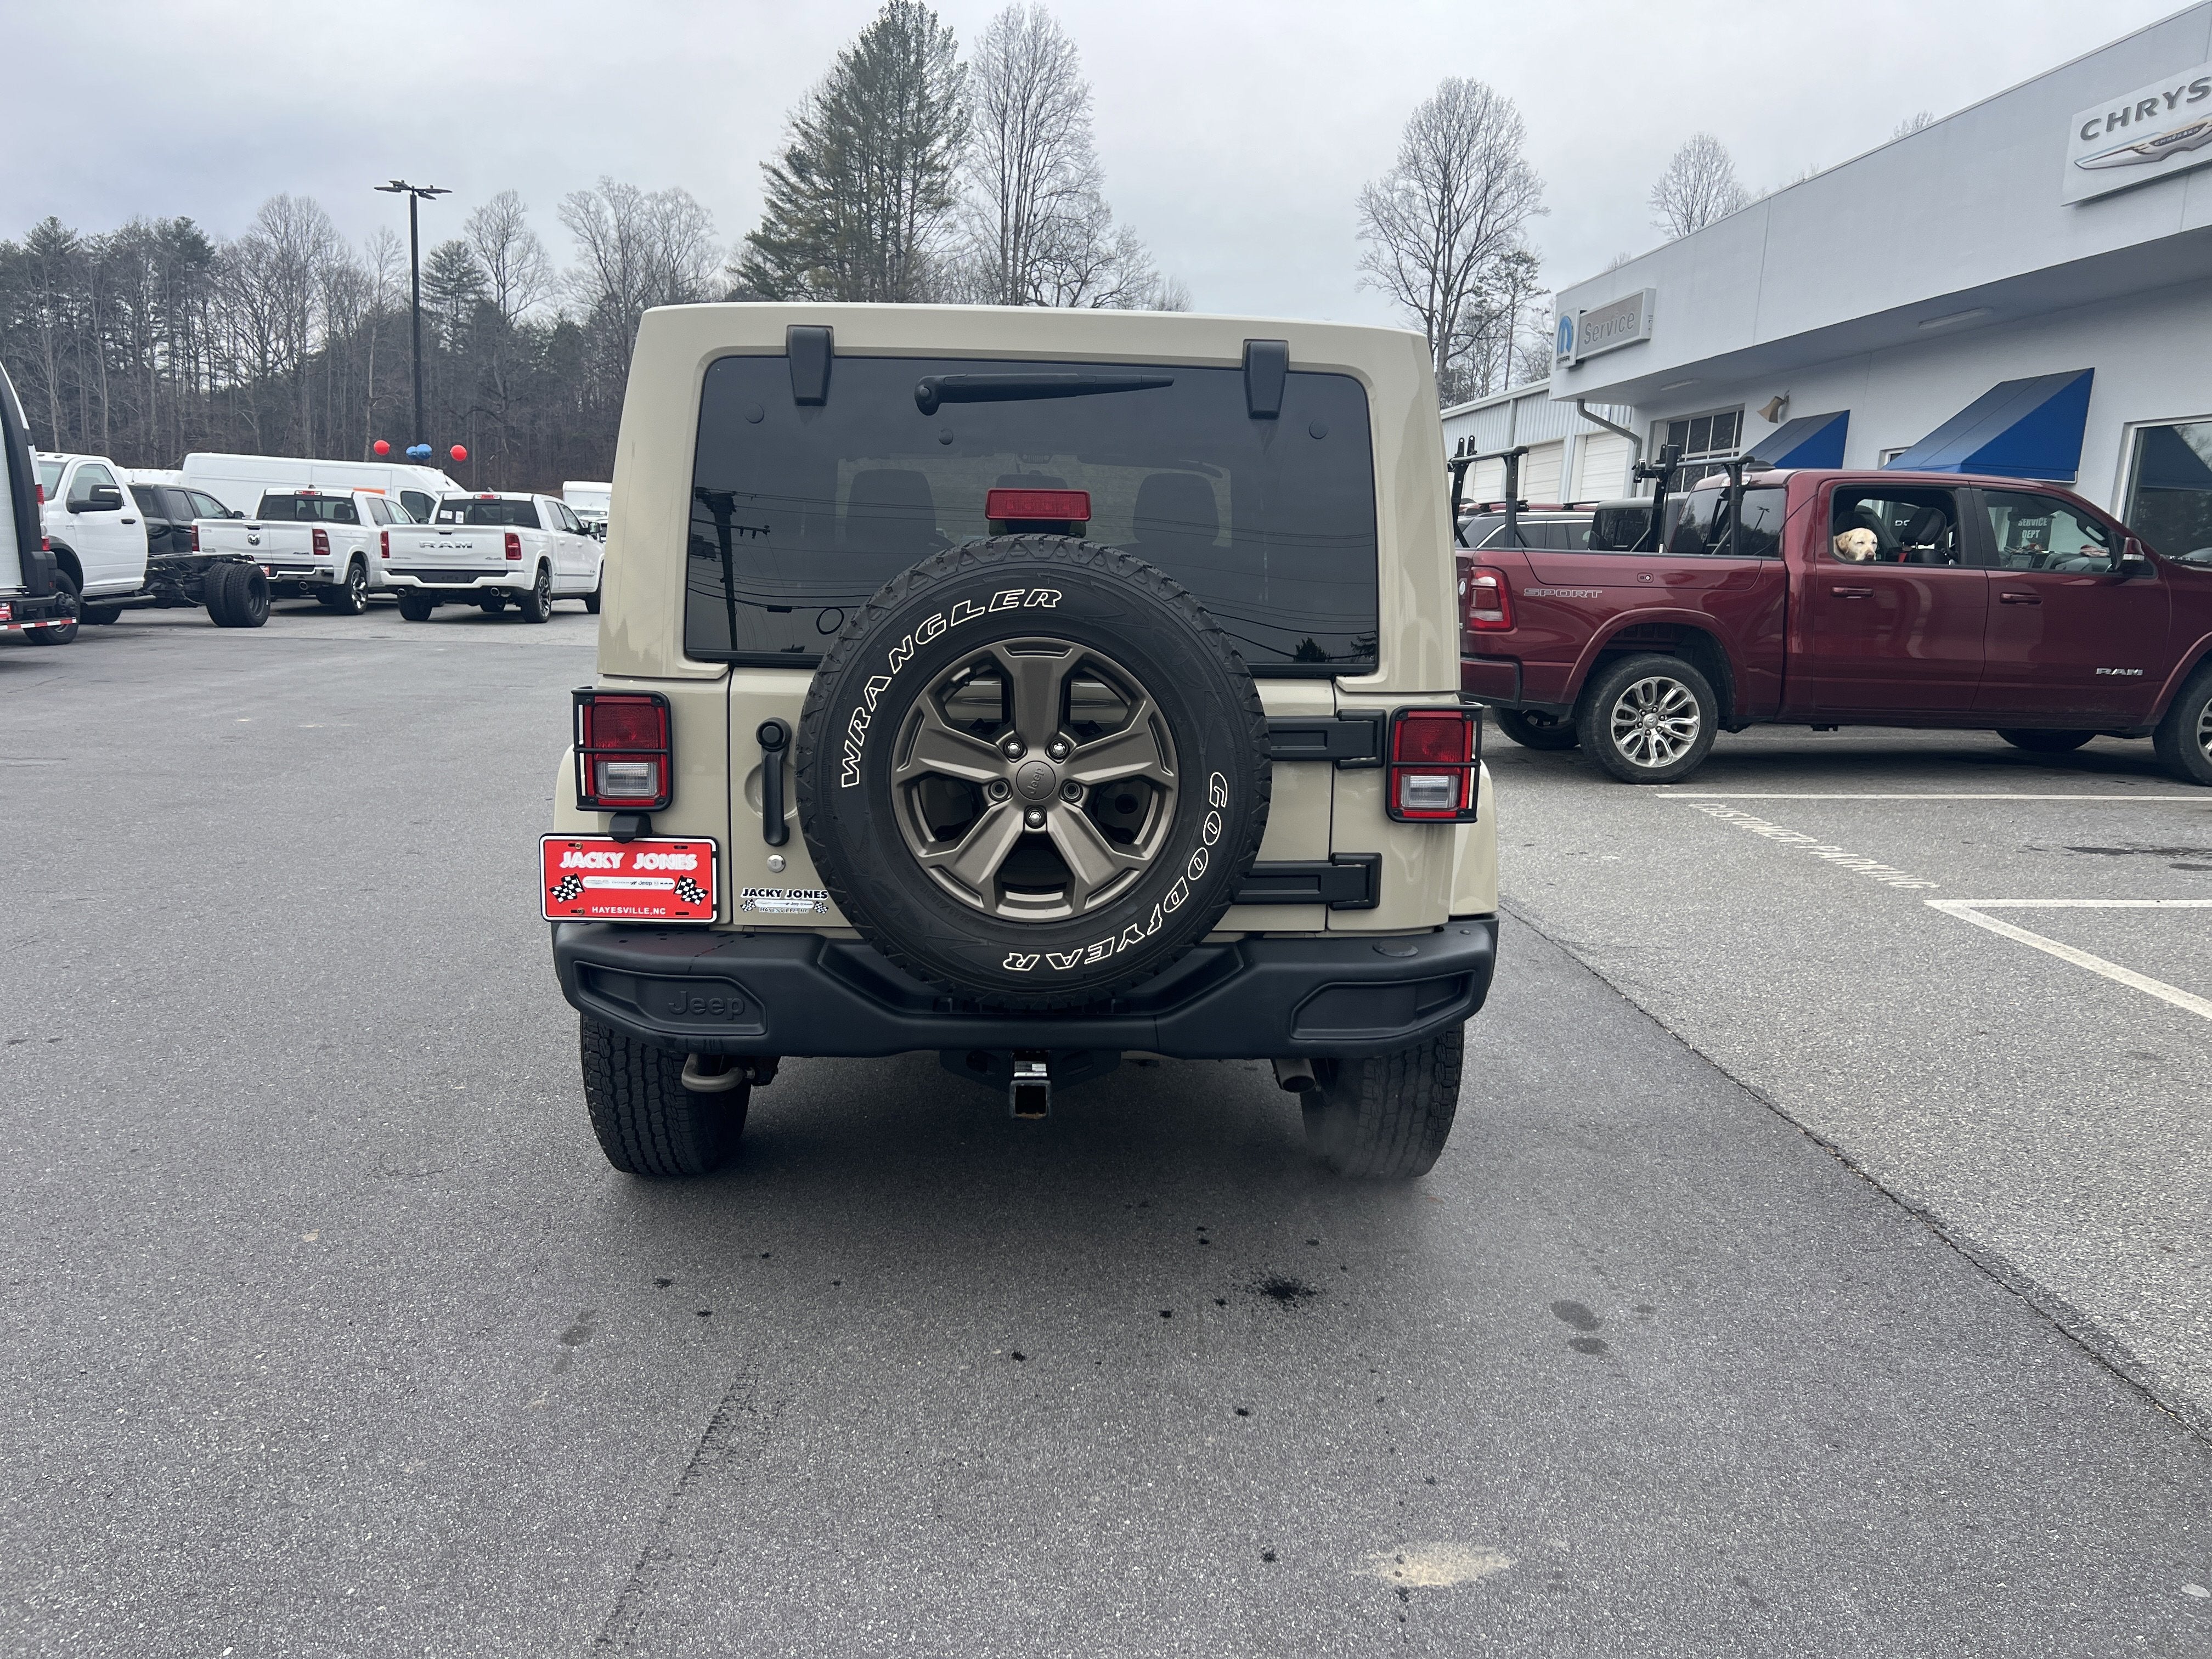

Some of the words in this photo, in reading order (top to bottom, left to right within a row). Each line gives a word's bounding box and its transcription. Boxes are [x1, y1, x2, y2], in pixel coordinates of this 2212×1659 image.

[1584, 312, 1635, 345] Service
[2018, 517, 2048, 527] SERVICE
[2022, 529, 2041, 539] DEPT
[419, 540, 472, 549] RAM
[1523, 588, 1602, 599] SPORT
[2096, 667, 2143, 676] RAM
[840, 589, 1062, 788] WRANGLER
[1027, 766, 1045, 796] Jeep
[560, 851, 625, 869] JACKY
[633, 853, 698, 871] JONES
[1002, 771, 1228, 971] GOODYEAR
[742, 888, 783, 898] JACKY
[786, 889, 829, 900] JONES
[668, 991, 745, 1021] Jeep
